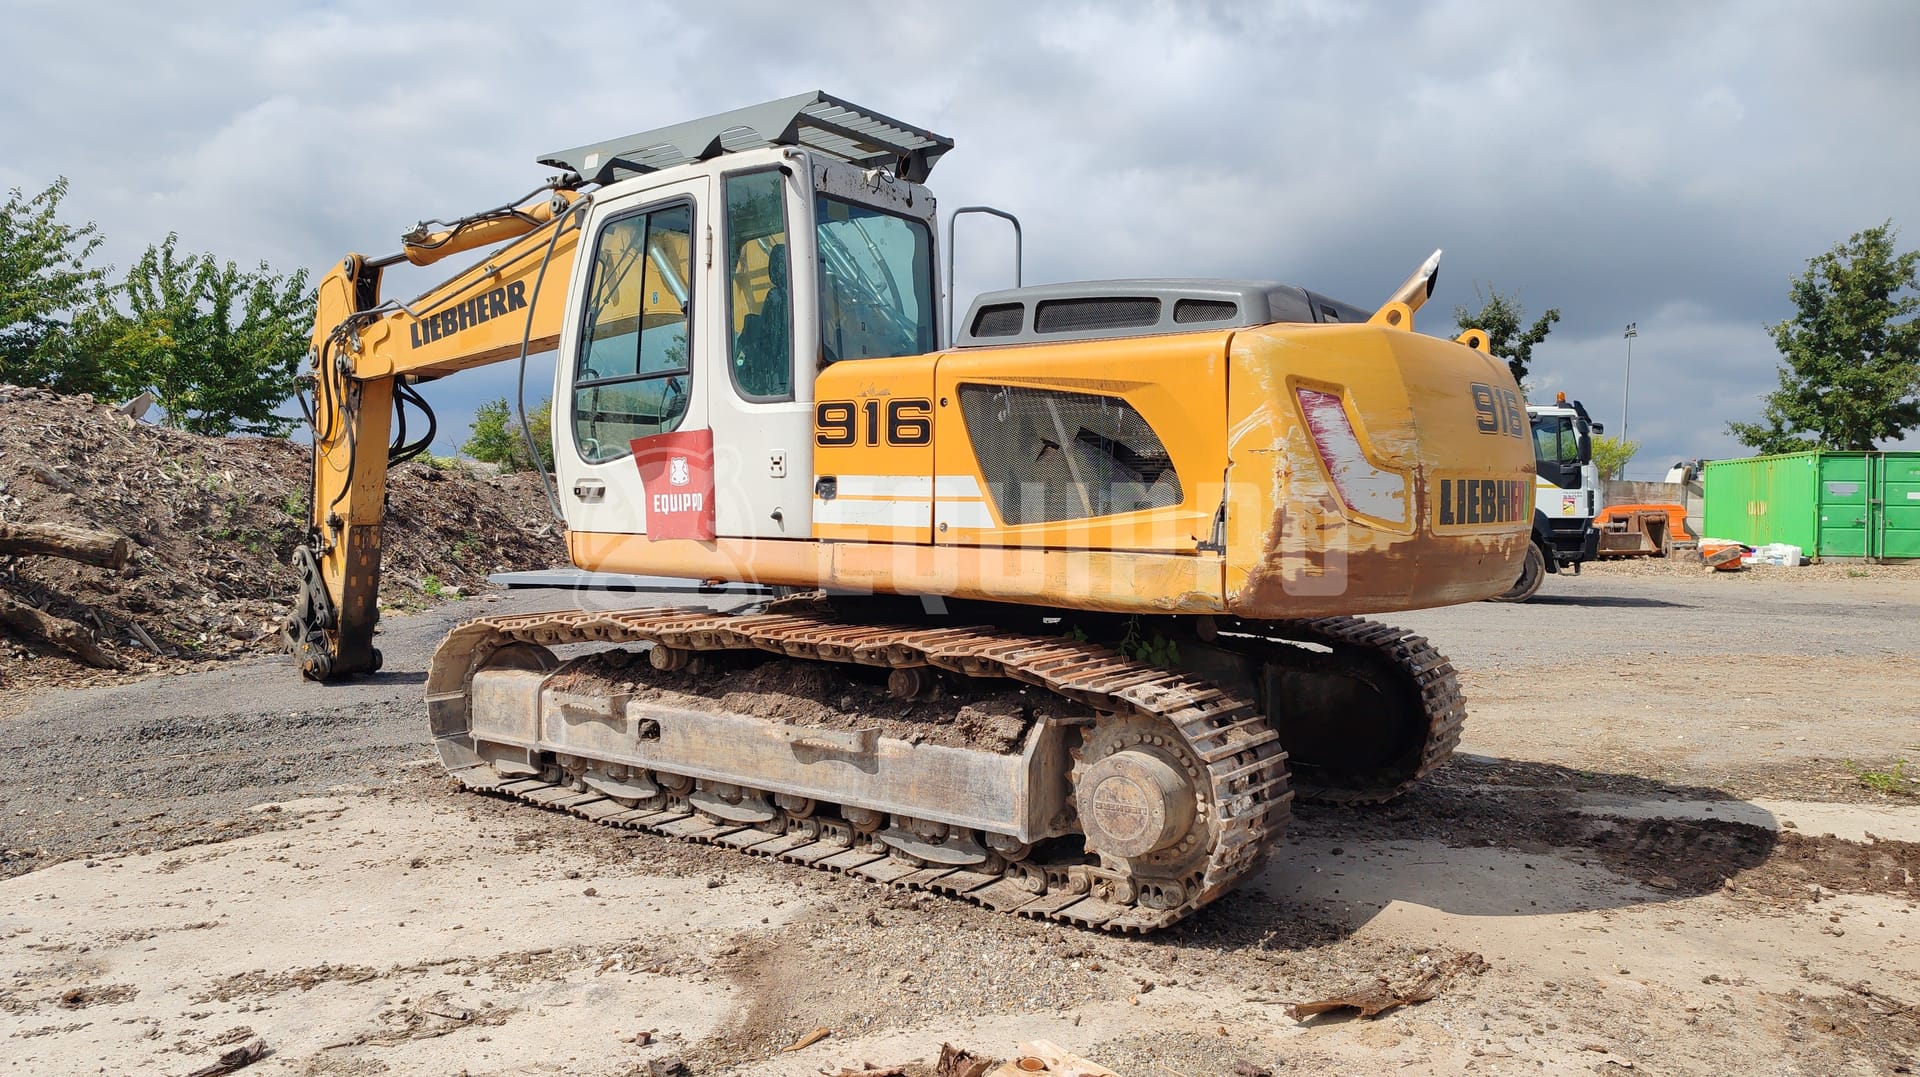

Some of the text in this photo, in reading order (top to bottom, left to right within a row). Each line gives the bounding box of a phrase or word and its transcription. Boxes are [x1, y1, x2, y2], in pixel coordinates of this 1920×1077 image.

[410, 280, 528, 349] LIEBHERR
[815, 397, 933, 447] 916
[1470, 382, 1523, 439] 916
[653, 493, 703, 514] EQUIPPO
